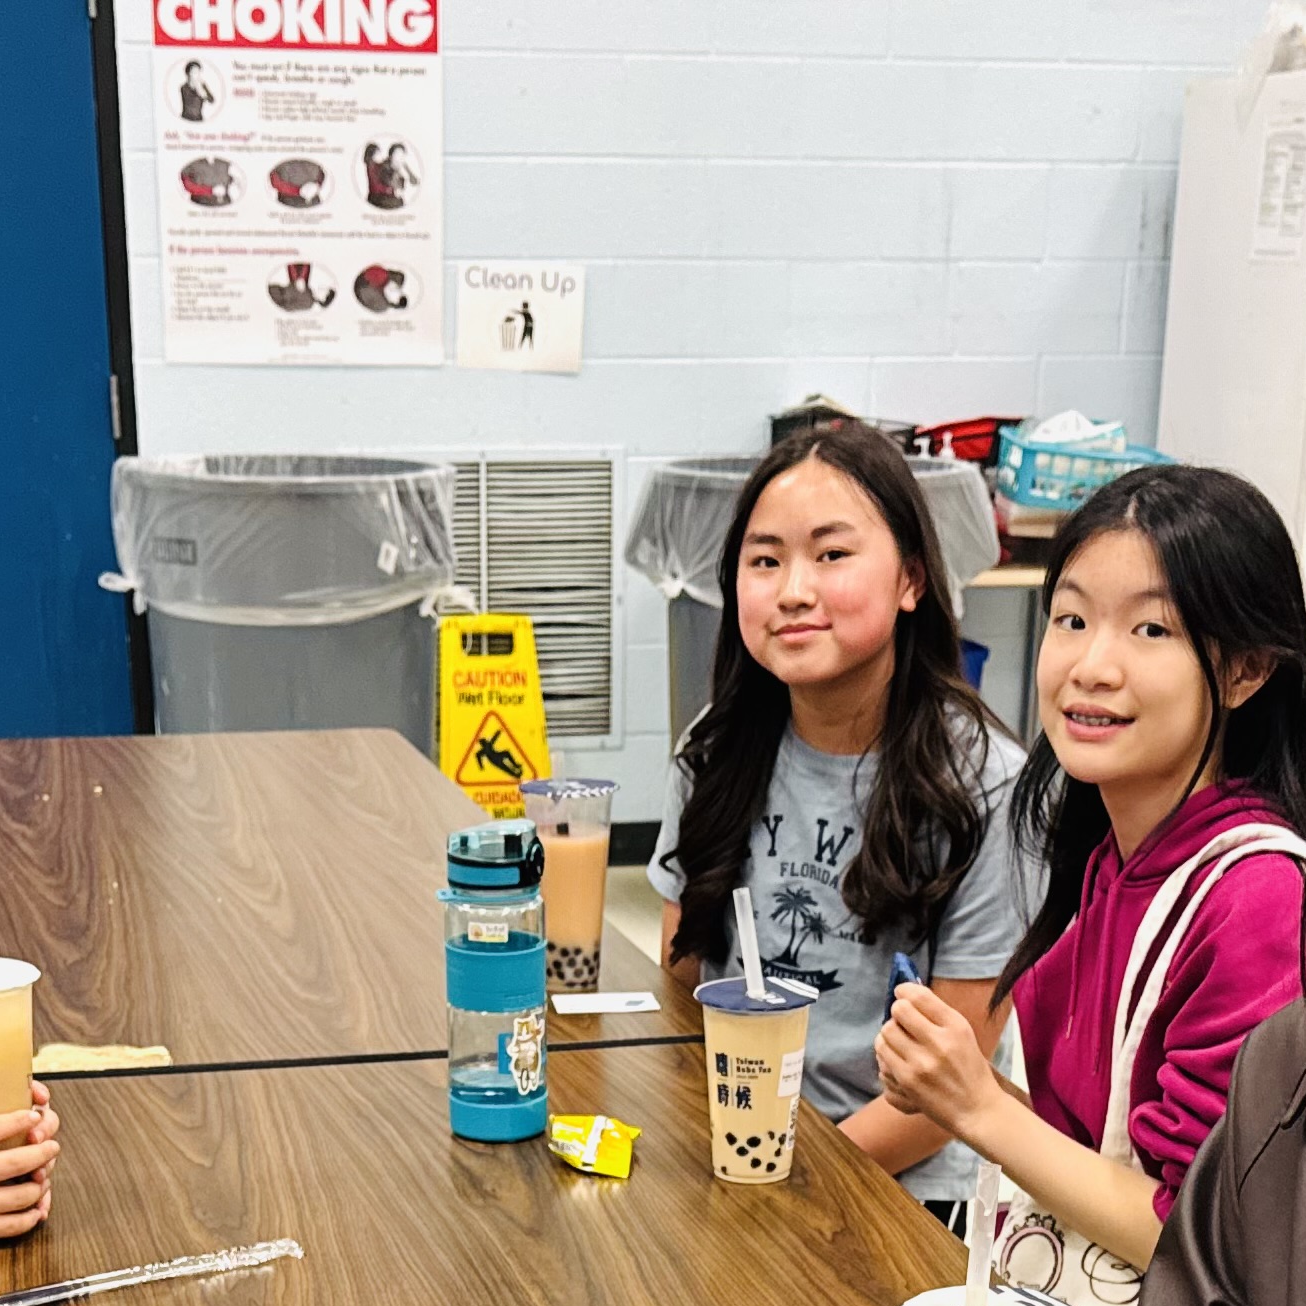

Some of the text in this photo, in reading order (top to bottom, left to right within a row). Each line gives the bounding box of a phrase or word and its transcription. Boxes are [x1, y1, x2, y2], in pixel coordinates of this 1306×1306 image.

[157, 0, 434, 47] CHOKING
[465, 265, 576, 298] Clean Up
[452, 671, 528, 688] CAUTION
[457, 690, 525, 705] Wet Floor
[780, 861, 840, 889] FLORIDA
